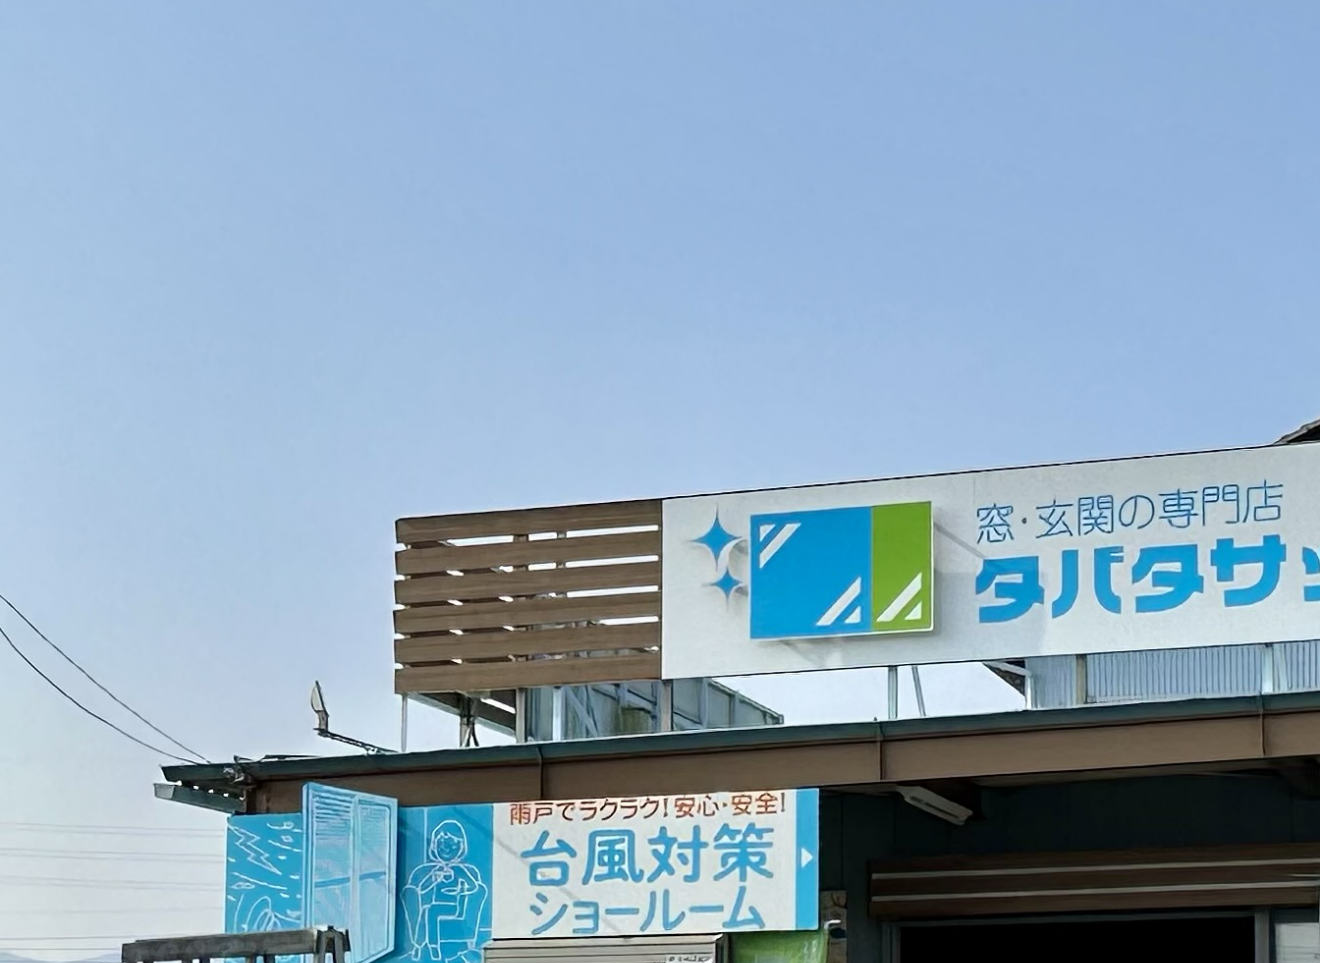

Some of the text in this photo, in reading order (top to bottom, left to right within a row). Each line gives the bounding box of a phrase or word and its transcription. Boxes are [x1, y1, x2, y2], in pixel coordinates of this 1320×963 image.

[976, 479, 1284, 545] 窓・玄関の専門店
[520, 823, 775, 887] 台風対策
[529, 886, 766, 937] ショールーム
